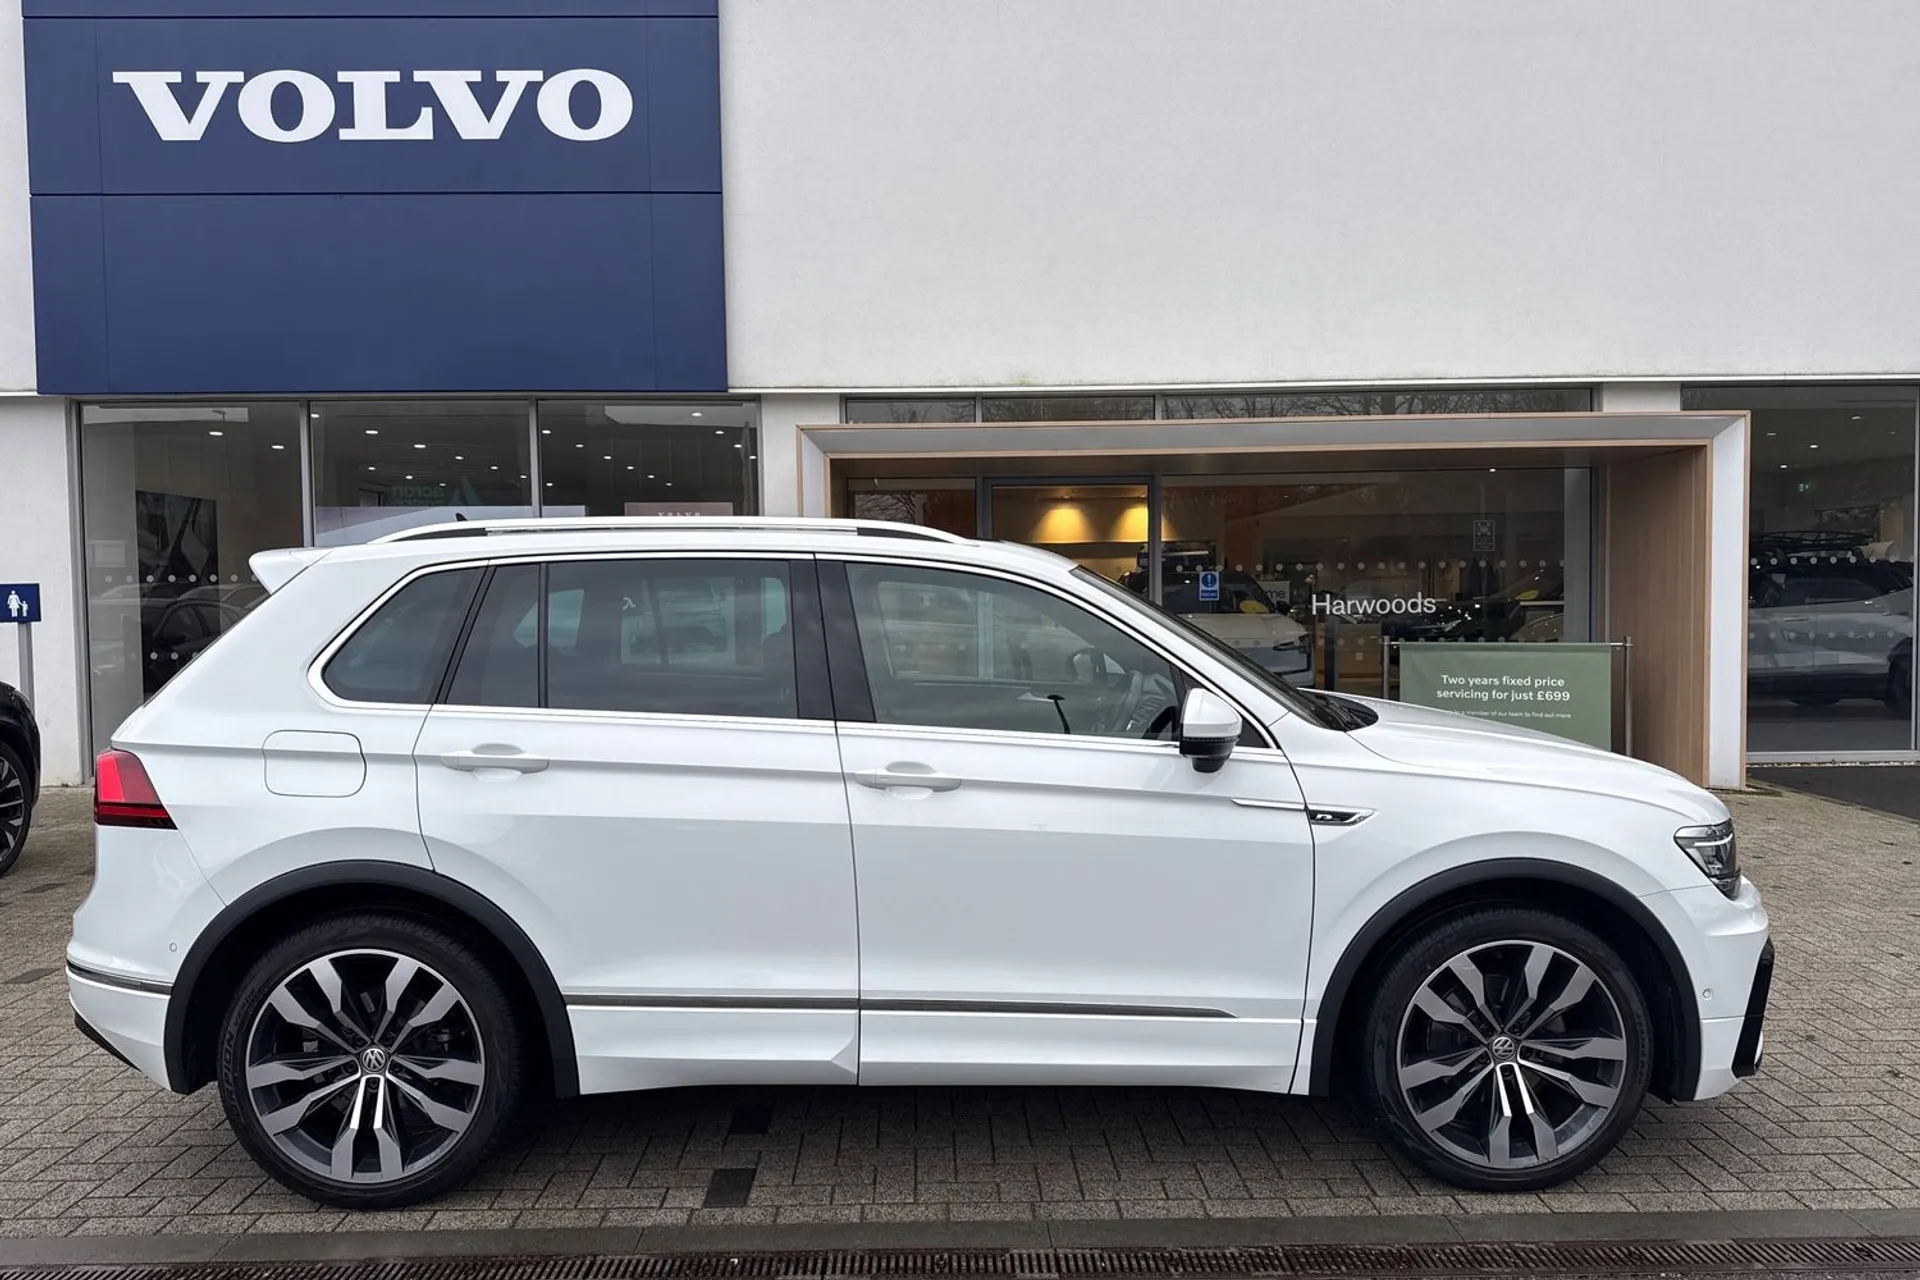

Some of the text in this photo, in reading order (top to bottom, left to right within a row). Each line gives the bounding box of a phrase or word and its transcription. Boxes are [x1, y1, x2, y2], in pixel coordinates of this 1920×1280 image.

[112, 68, 634, 143] VOLVO
[1311, 591, 1437, 615] Harwoods
[1440, 674, 1565, 688] Two years fixed price
[1436, 689, 1571, 702] servicing for just £699
